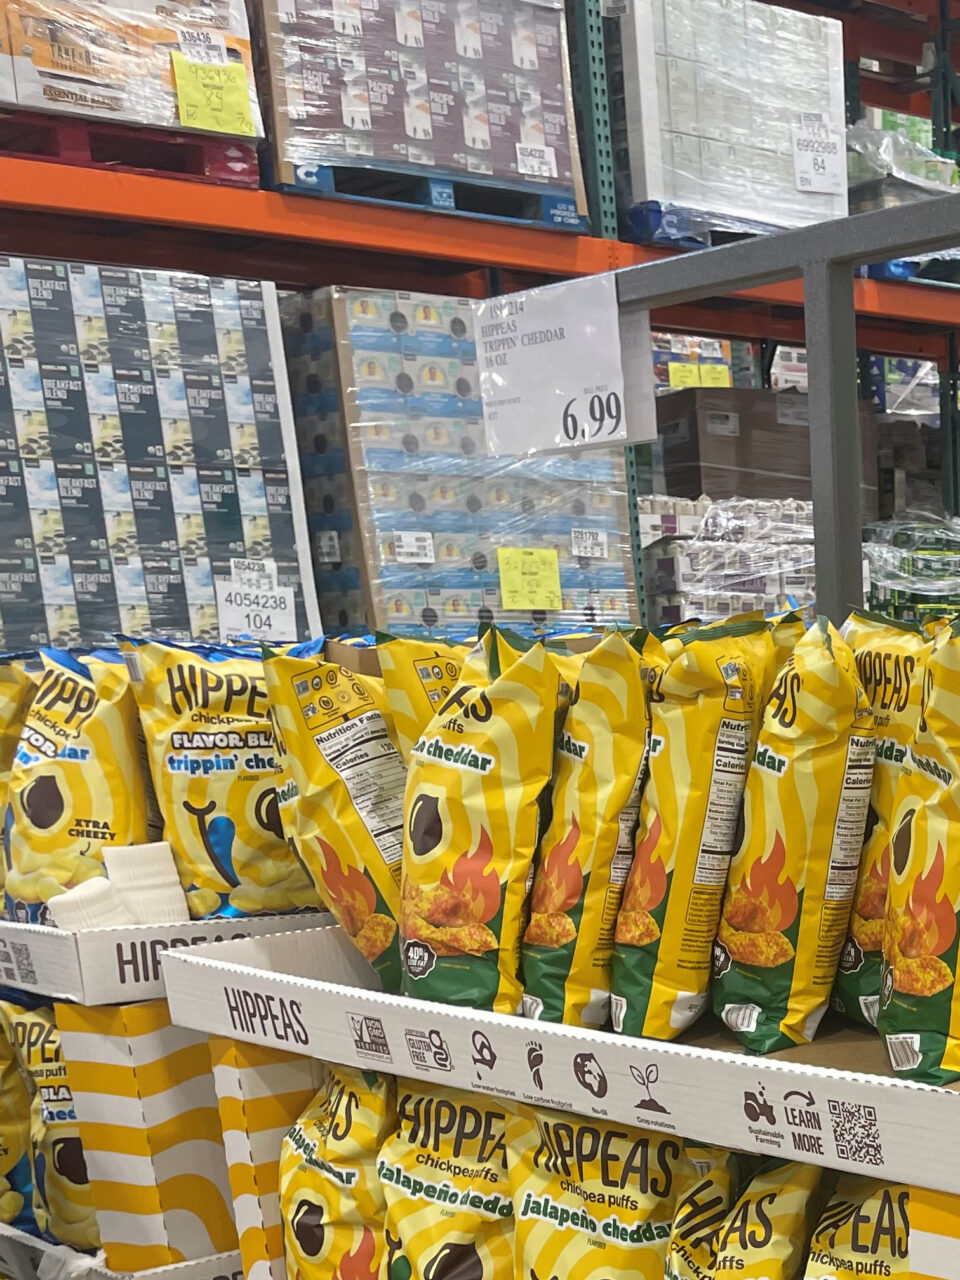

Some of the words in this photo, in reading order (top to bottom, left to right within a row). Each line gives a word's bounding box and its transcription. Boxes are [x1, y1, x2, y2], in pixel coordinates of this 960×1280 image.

[180, 31, 212, 44] 936436
[813, 158, 825, 171] 84
[28, 279, 68, 292] BREAKFAST
[30, 289, 52, 300] BLEND
[481, 320, 517, 338] HIPPEAS
[522, 328, 565, 346] CHEDDAR
[485, 356, 494, 368] 16
[495, 353, 508, 367] OZ
[116, 383, 154, 395] BREAKFAST
[563, 392, 621, 440] 6.99
[58, 478, 97, 489] BREAKFAST
[225, 592, 287, 610] 4054238
[245, 614, 272, 630] 104
[173, 732, 244, 749] FLAVOR
[315, 722, 358, 745] Nutrition
[168, 753, 239, 775] trippin'
[335, 752, 369, 769] Calories
[427, 741, 492, 772] cheddar
[74, 819, 111, 831] XTRA
[68, 829, 117, 841] CHEEZY
[224, 986, 310, 1046] HIPPEAS
[409, 1037, 431, 1053] GLUTEN
[412, 1051, 428, 1064] FREE
[784, 1107, 823, 1131] LEARN
[791, 1131, 825, 1157] MORE
[378, 1160, 459, 1206] jalapeño
[560, 1177, 606, 1204] chickpea
[607, 1195, 640, 1212] puffs
[521, 1194, 597, 1233] jalapeño
